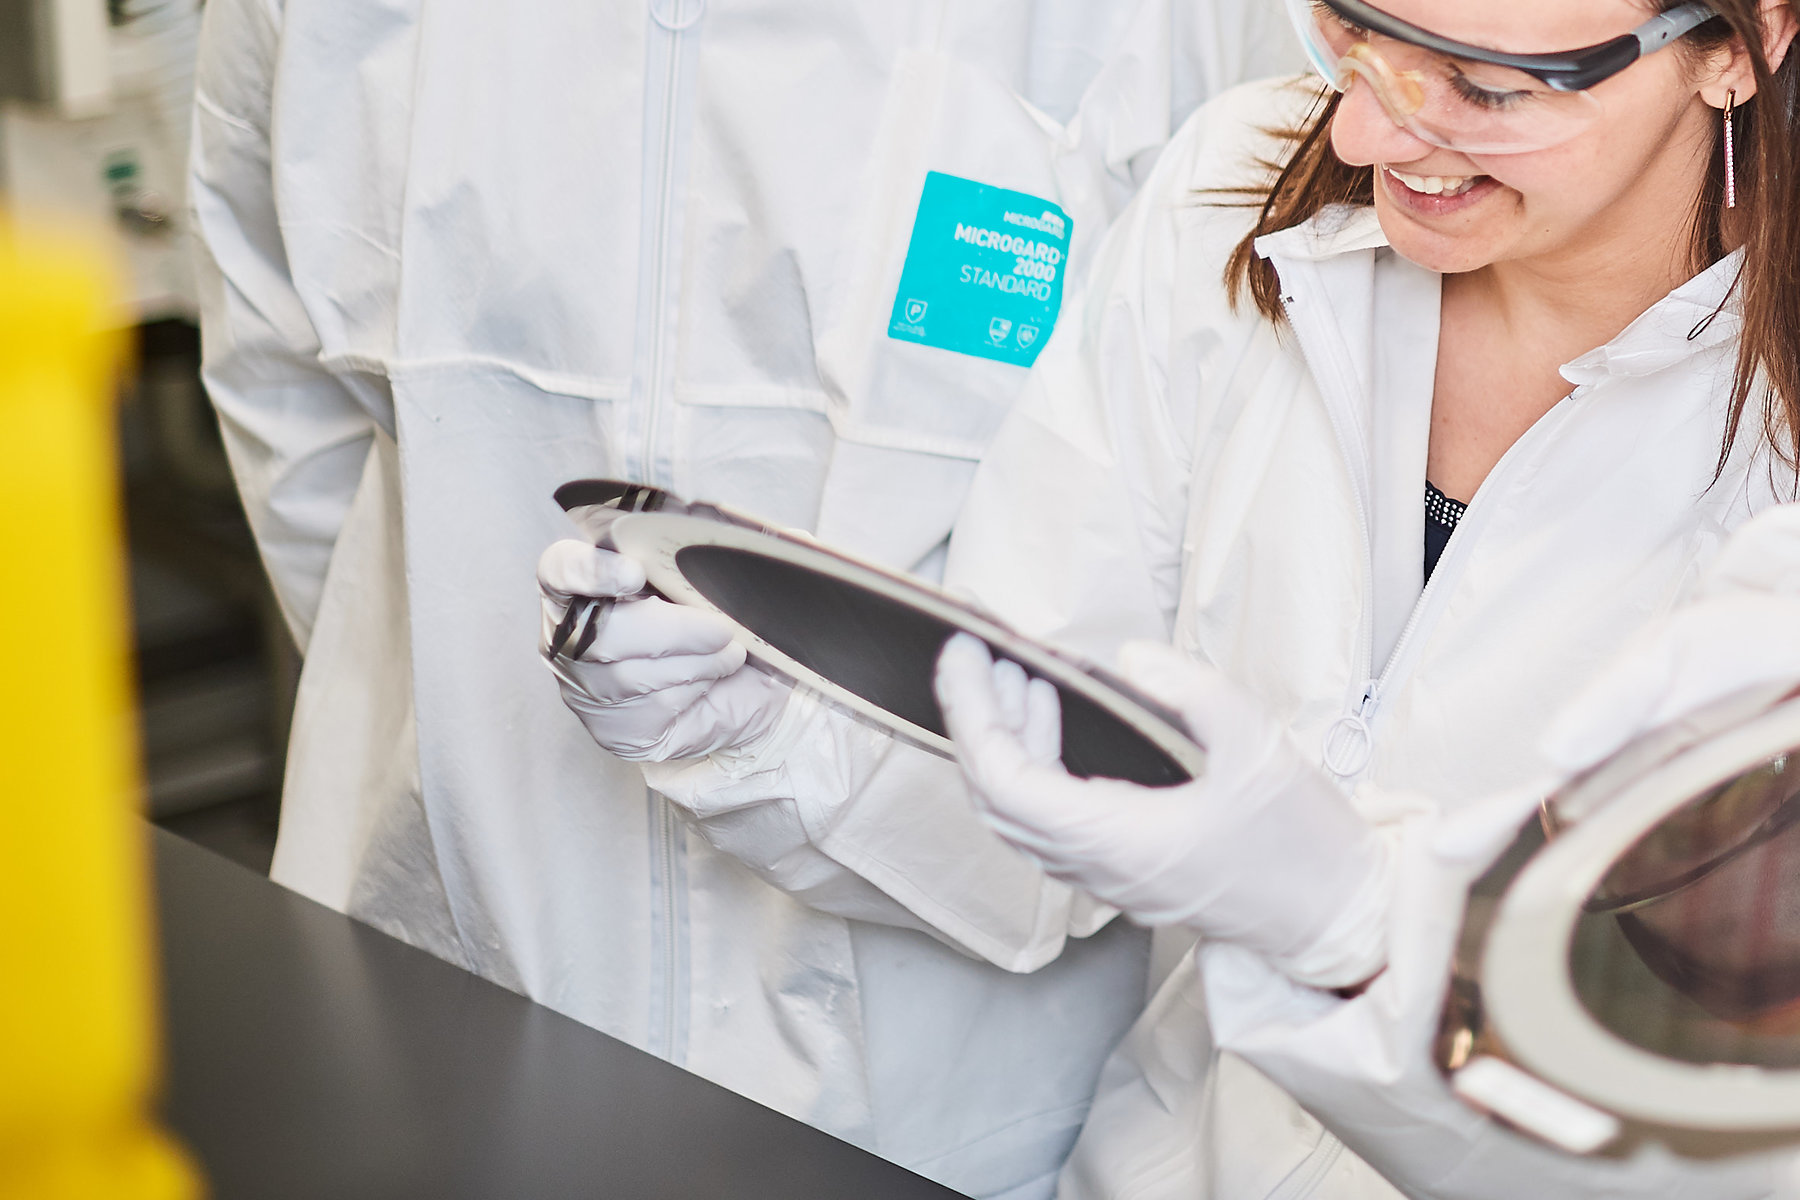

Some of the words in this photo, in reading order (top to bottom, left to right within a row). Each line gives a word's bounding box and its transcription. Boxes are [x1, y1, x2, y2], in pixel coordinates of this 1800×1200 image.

[954, 222, 1061, 265] MICROGARD
[959, 264, 1051, 301] STANDARD
[1013, 256, 1056, 282] 2000
